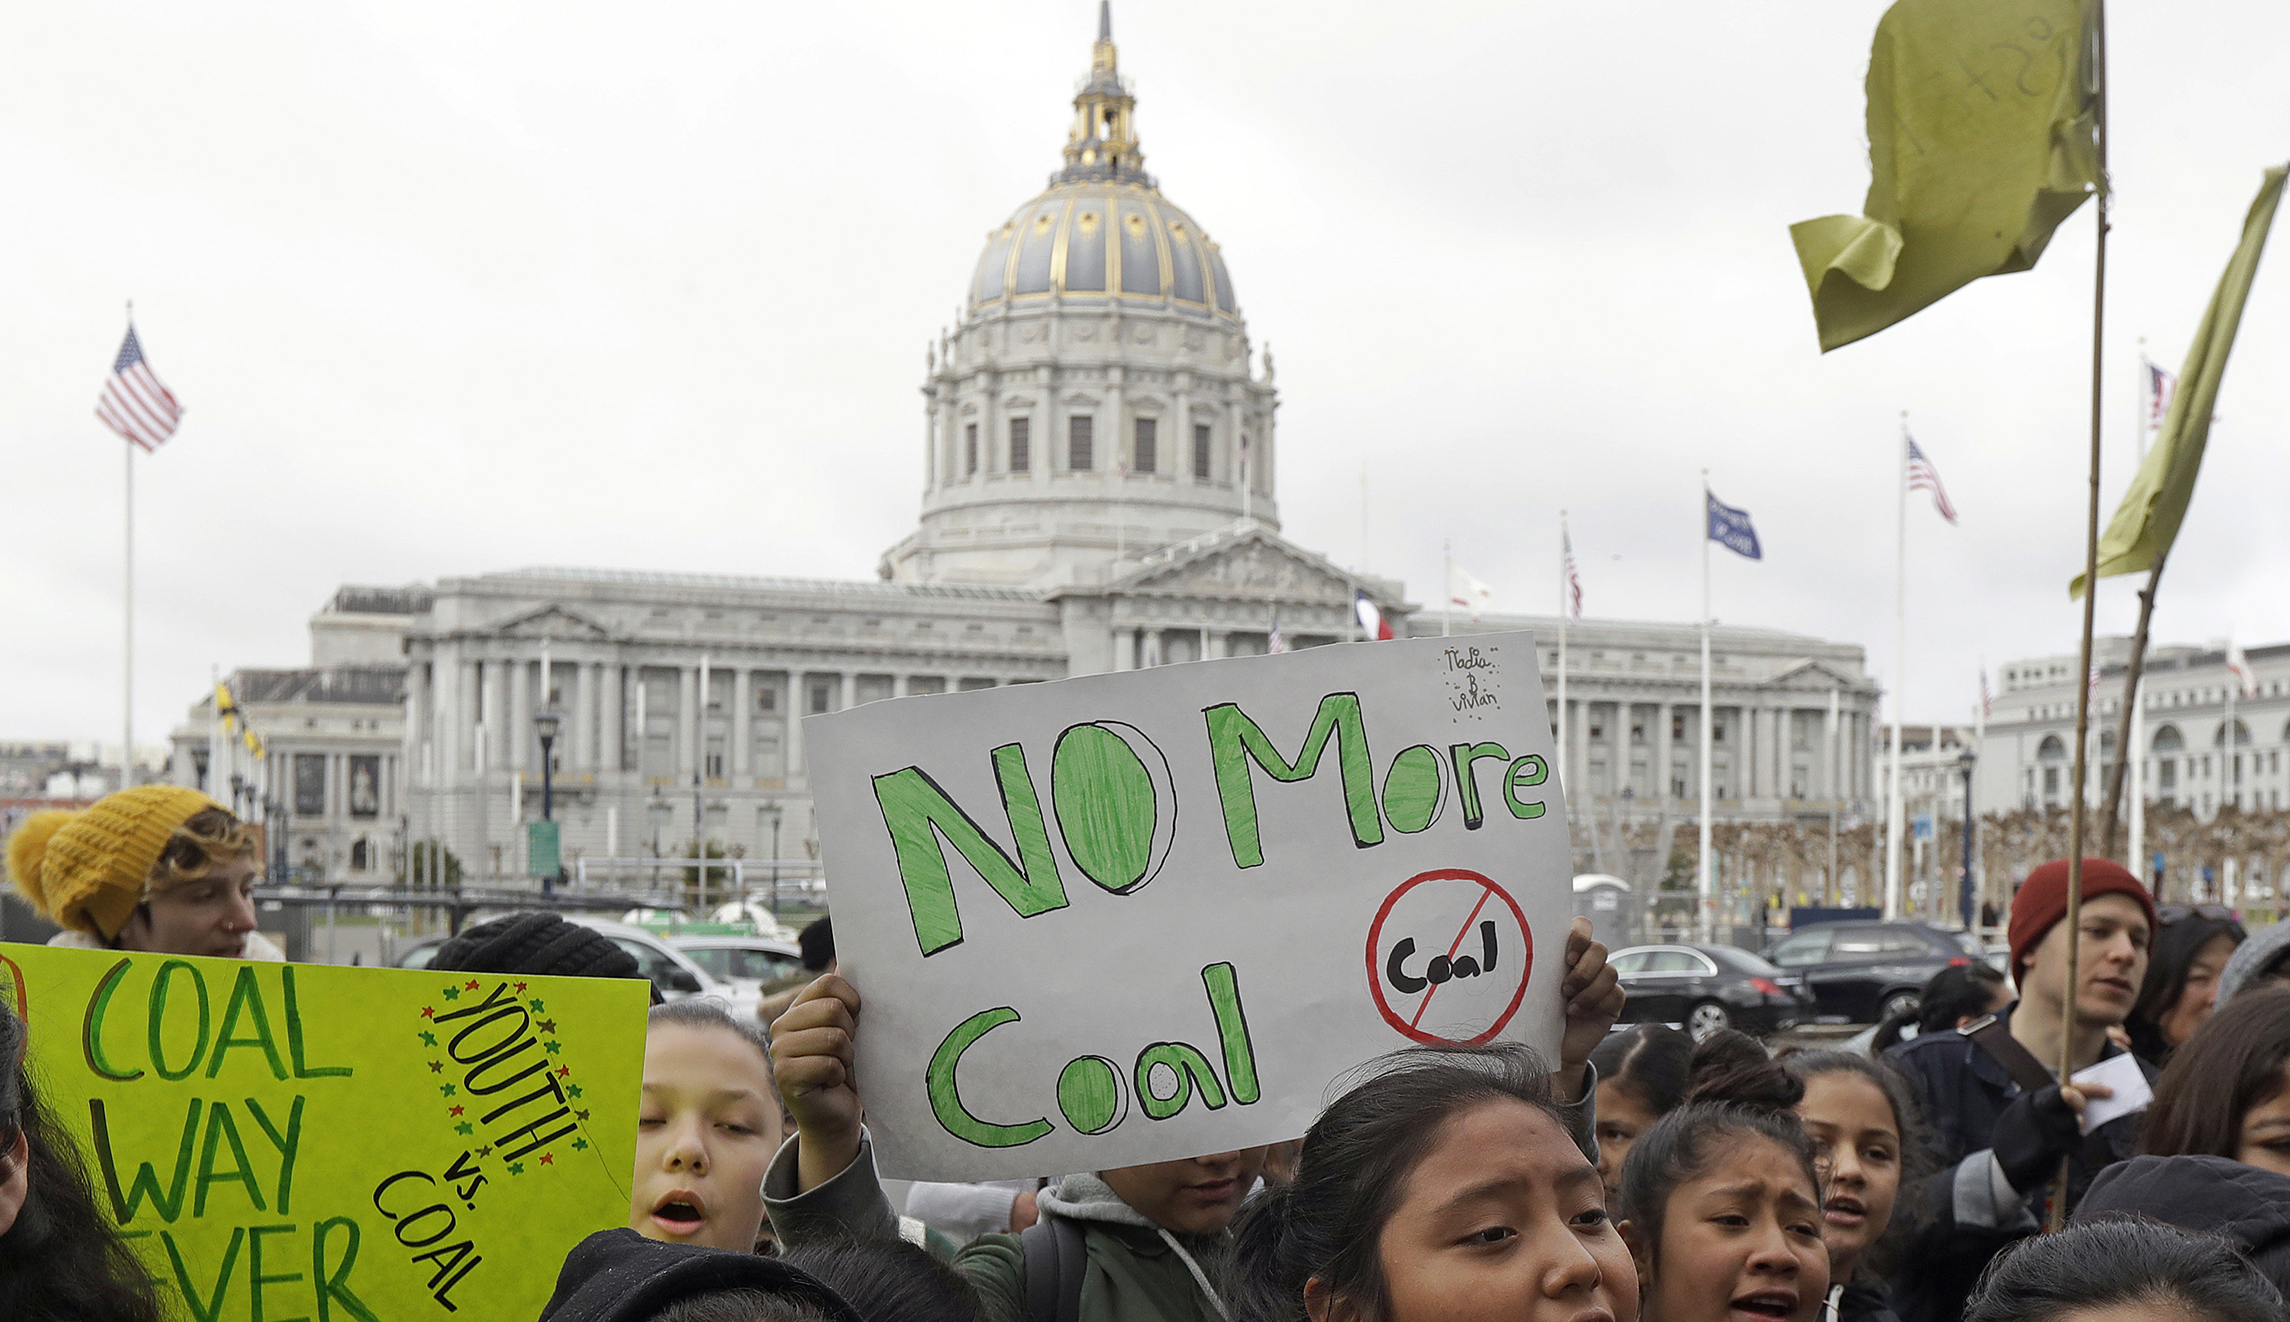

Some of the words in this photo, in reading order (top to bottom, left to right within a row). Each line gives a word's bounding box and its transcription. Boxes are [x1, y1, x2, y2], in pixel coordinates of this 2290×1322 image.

[872, 720, 1177, 957] NO
[1201, 692, 1549, 868] More
[82, 957, 353, 1082] COAL
[1386, 920, 1498, 994] Coal
[433, 982, 577, 1163] YOUTH
[926, 962, 1261, 1148] Coal
[89, 1095, 305, 1225] WAY
[372, 1171, 484, 1314] COAL
